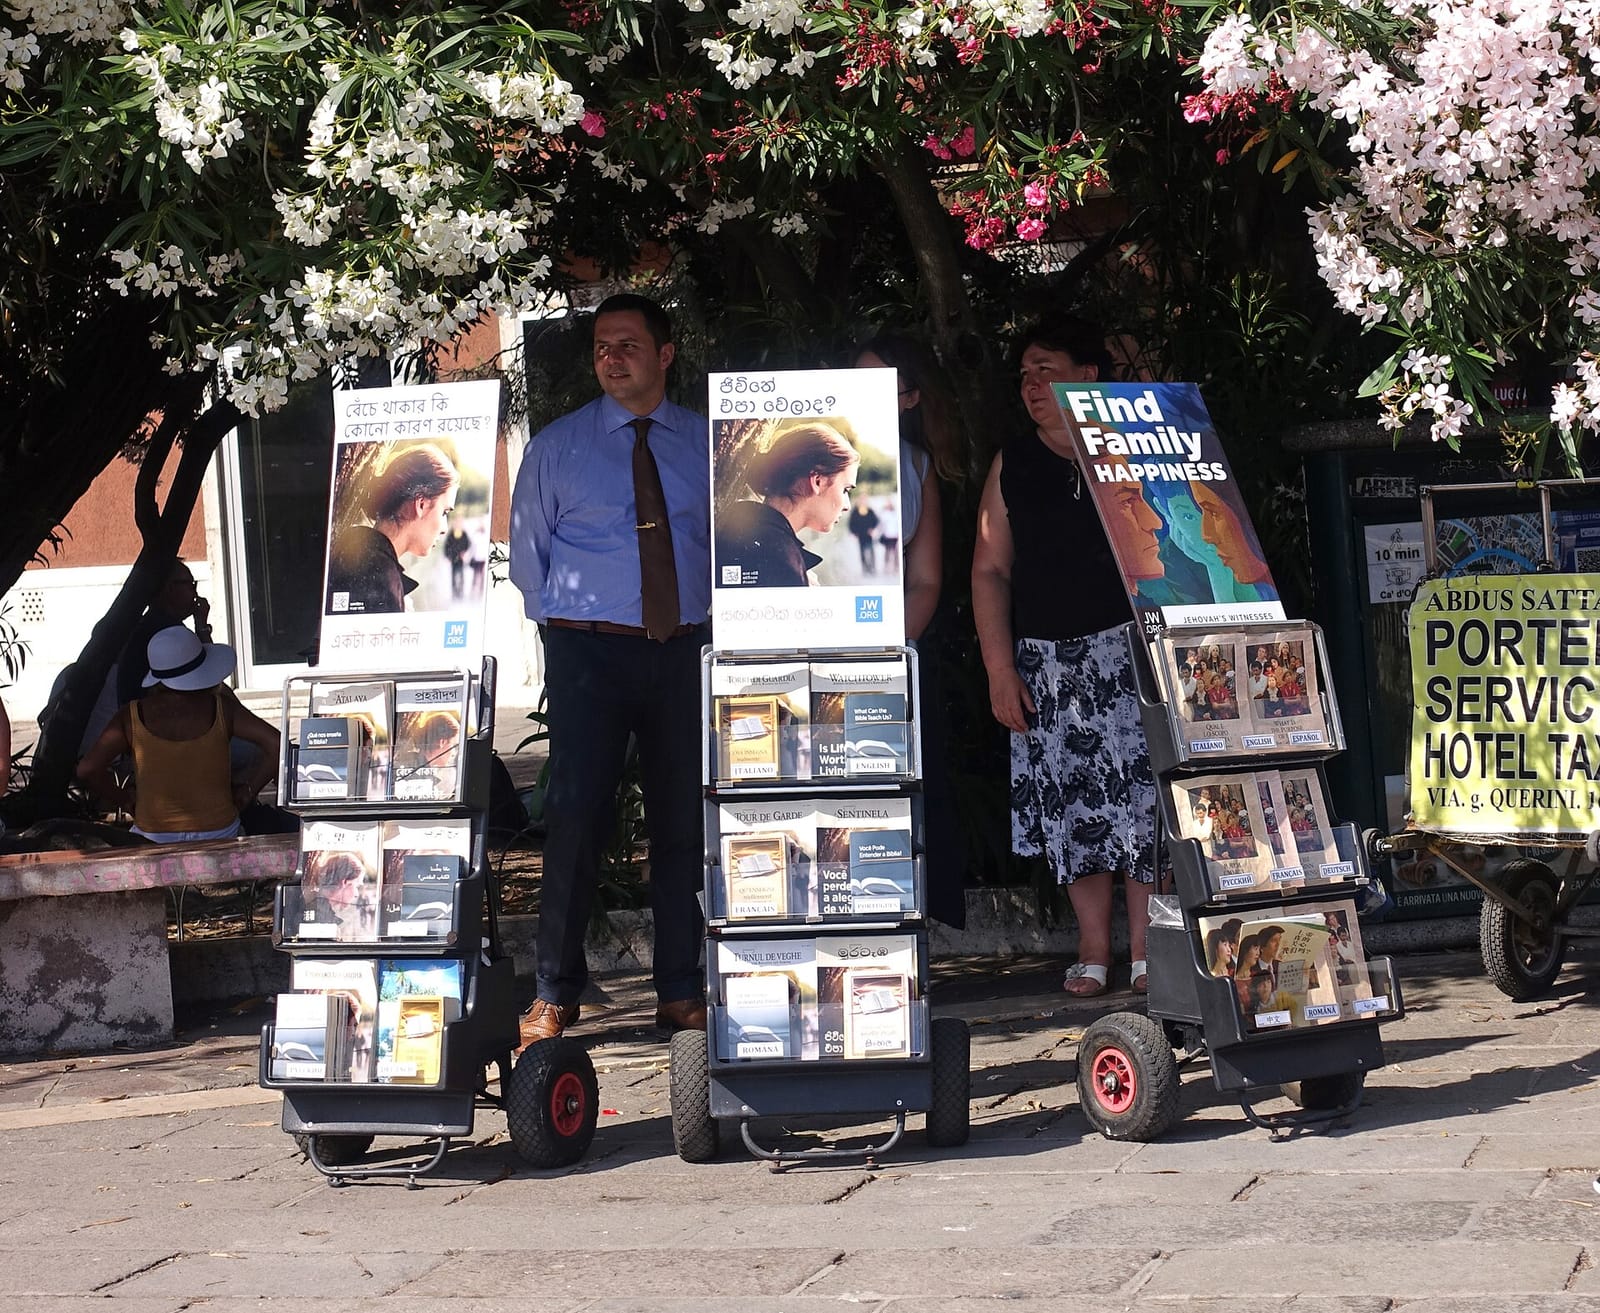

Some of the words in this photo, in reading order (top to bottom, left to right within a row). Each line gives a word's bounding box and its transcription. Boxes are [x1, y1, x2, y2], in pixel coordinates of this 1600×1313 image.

[345, 397, 377, 418] বেঁচে
[383, 401, 426, 415] থাকার
[431, 392, 449, 411] কি
[1065, 390, 1165, 423] Find
[344, 421, 389, 439] কোনো
[393, 418, 432, 434] কারণ
[1080, 426, 1202, 462] Family
[1094, 462, 1228, 483] HAPPINESS
[1375, 549, 1391, 561] 10
[1395, 548, 1421, 560] min
[1380, 590, 1394, 599] Ca'
[1424, 588, 1514, 612] ABDUS
[858, 599, 879, 611] JW
[858, 610, 879, 620] .ORG
[1144, 611, 1160, 624] JW
[1183, 613, 1227, 624] JEHOVAH'S
[1228, 611, 1274, 622] WITNESSES
[447, 623, 465, 637] JW
[762, 674, 796, 683] GUARDIA
[829, 673, 893, 683] WATCHTOWER
[1425, 675, 1595, 724] SERVIC
[1246, 739, 1273, 747] ENGLISH
[1292, 733, 1319, 742] ESPAÑOL
[819, 743, 828, 753] Is
[1192, 741, 1223, 750] ITALIANO
[1424, 732, 1538, 780] HOTEL
[1548, 733, 1600, 781] TA
[734, 767, 774, 776] ITALIANO
[1427, 786, 1465, 808] VIA.
[1490, 787, 1580, 812] QUERINI.
[735, 811, 757, 822] TOUR
[759, 812, 770, 821] DE
[773, 810, 803, 821] GARDE
[837, 808, 889, 819] SENTINELA
[823, 870, 847, 880] Você
[1272, 869, 1303, 881] FRANÇAIS
[1322, 865, 1351, 876] DEUTSCH
[823, 881, 851, 893] perde
[1222, 875, 1252, 887] РУССКИЙ
[823, 894, 829, 902] a
[1403, 892, 1440, 907] ARRIVATA
[1442, 892, 1459, 903] UNA
[735, 905, 775, 914] FRANÇAIS
[823, 903, 836, 914] de
[734, 952, 765, 962] TURNUL
[766, 953, 776, 961] DE
[777, 952, 802, 960] VEGHE
[1266, 1014, 1281, 1024] 中文
